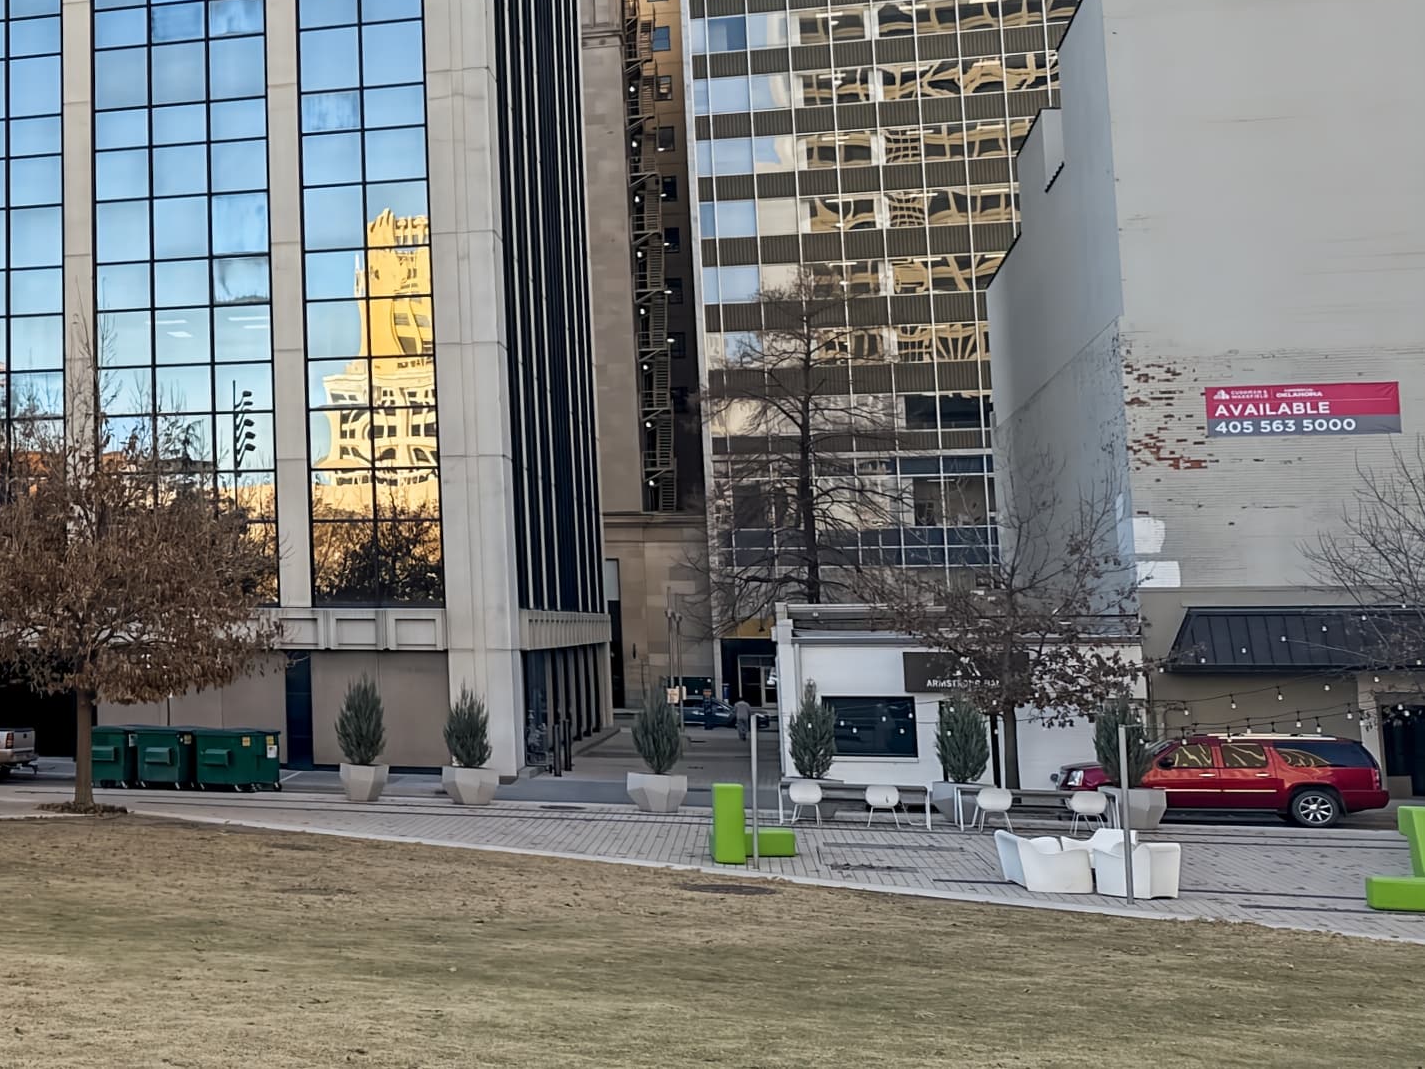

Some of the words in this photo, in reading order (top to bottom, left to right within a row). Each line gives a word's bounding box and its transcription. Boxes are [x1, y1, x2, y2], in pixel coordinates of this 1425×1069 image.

[1215, 402, 1330, 417] AVAILABLE
[1215, 420, 1254, 434] 405
[1260, 419, 1296, 433] 563
[1302, 418, 1356, 432] 5000
